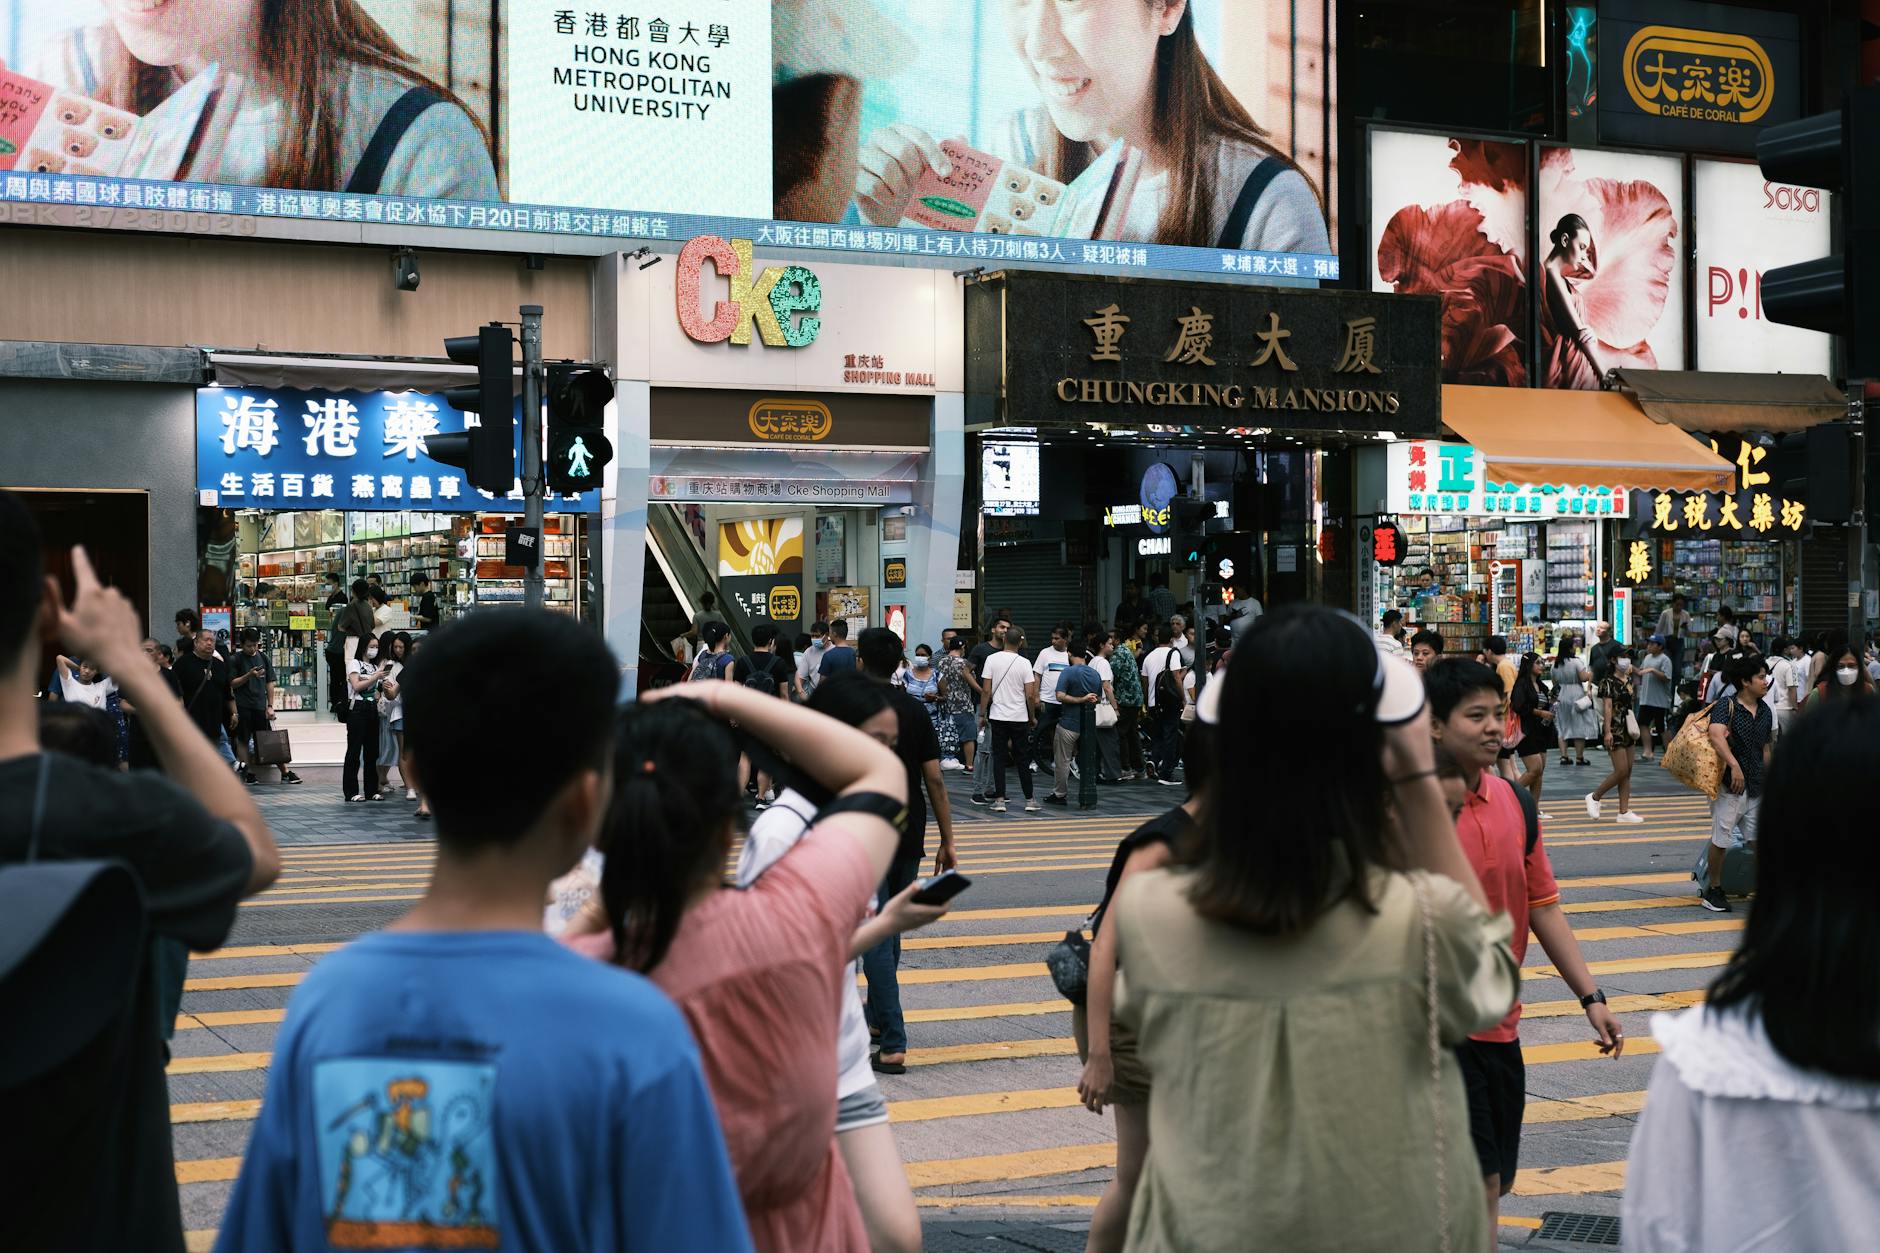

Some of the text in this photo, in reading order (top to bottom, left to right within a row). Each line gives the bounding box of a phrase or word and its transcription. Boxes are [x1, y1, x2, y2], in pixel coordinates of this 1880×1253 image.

[554, 10, 730, 48] 香港都會大學
[575, 44, 710, 73] HONG KONG
[553, 67, 731, 99] METROPOLITAN
[574, 93, 710, 120] UNIVERSITY
[1662, 104, 1738, 123] CAFÉ DE CORAL
[676, 234, 822, 349] Cke
[844, 354, 884, 369] 重庆站
[844, 370, 935, 386] SHOPPING MALL
[1056, 376, 1400, 414] CHUNGKING MANSIONS
[219, 396, 484, 460] 海港藥
[220, 472, 335, 497] 生活百貨
[352, 475, 461, 499] 燕窩蟲草
[688, 482, 781, 496] 重庆站購物商場
[787, 485, 890, 499] Cke Shopping Mall
